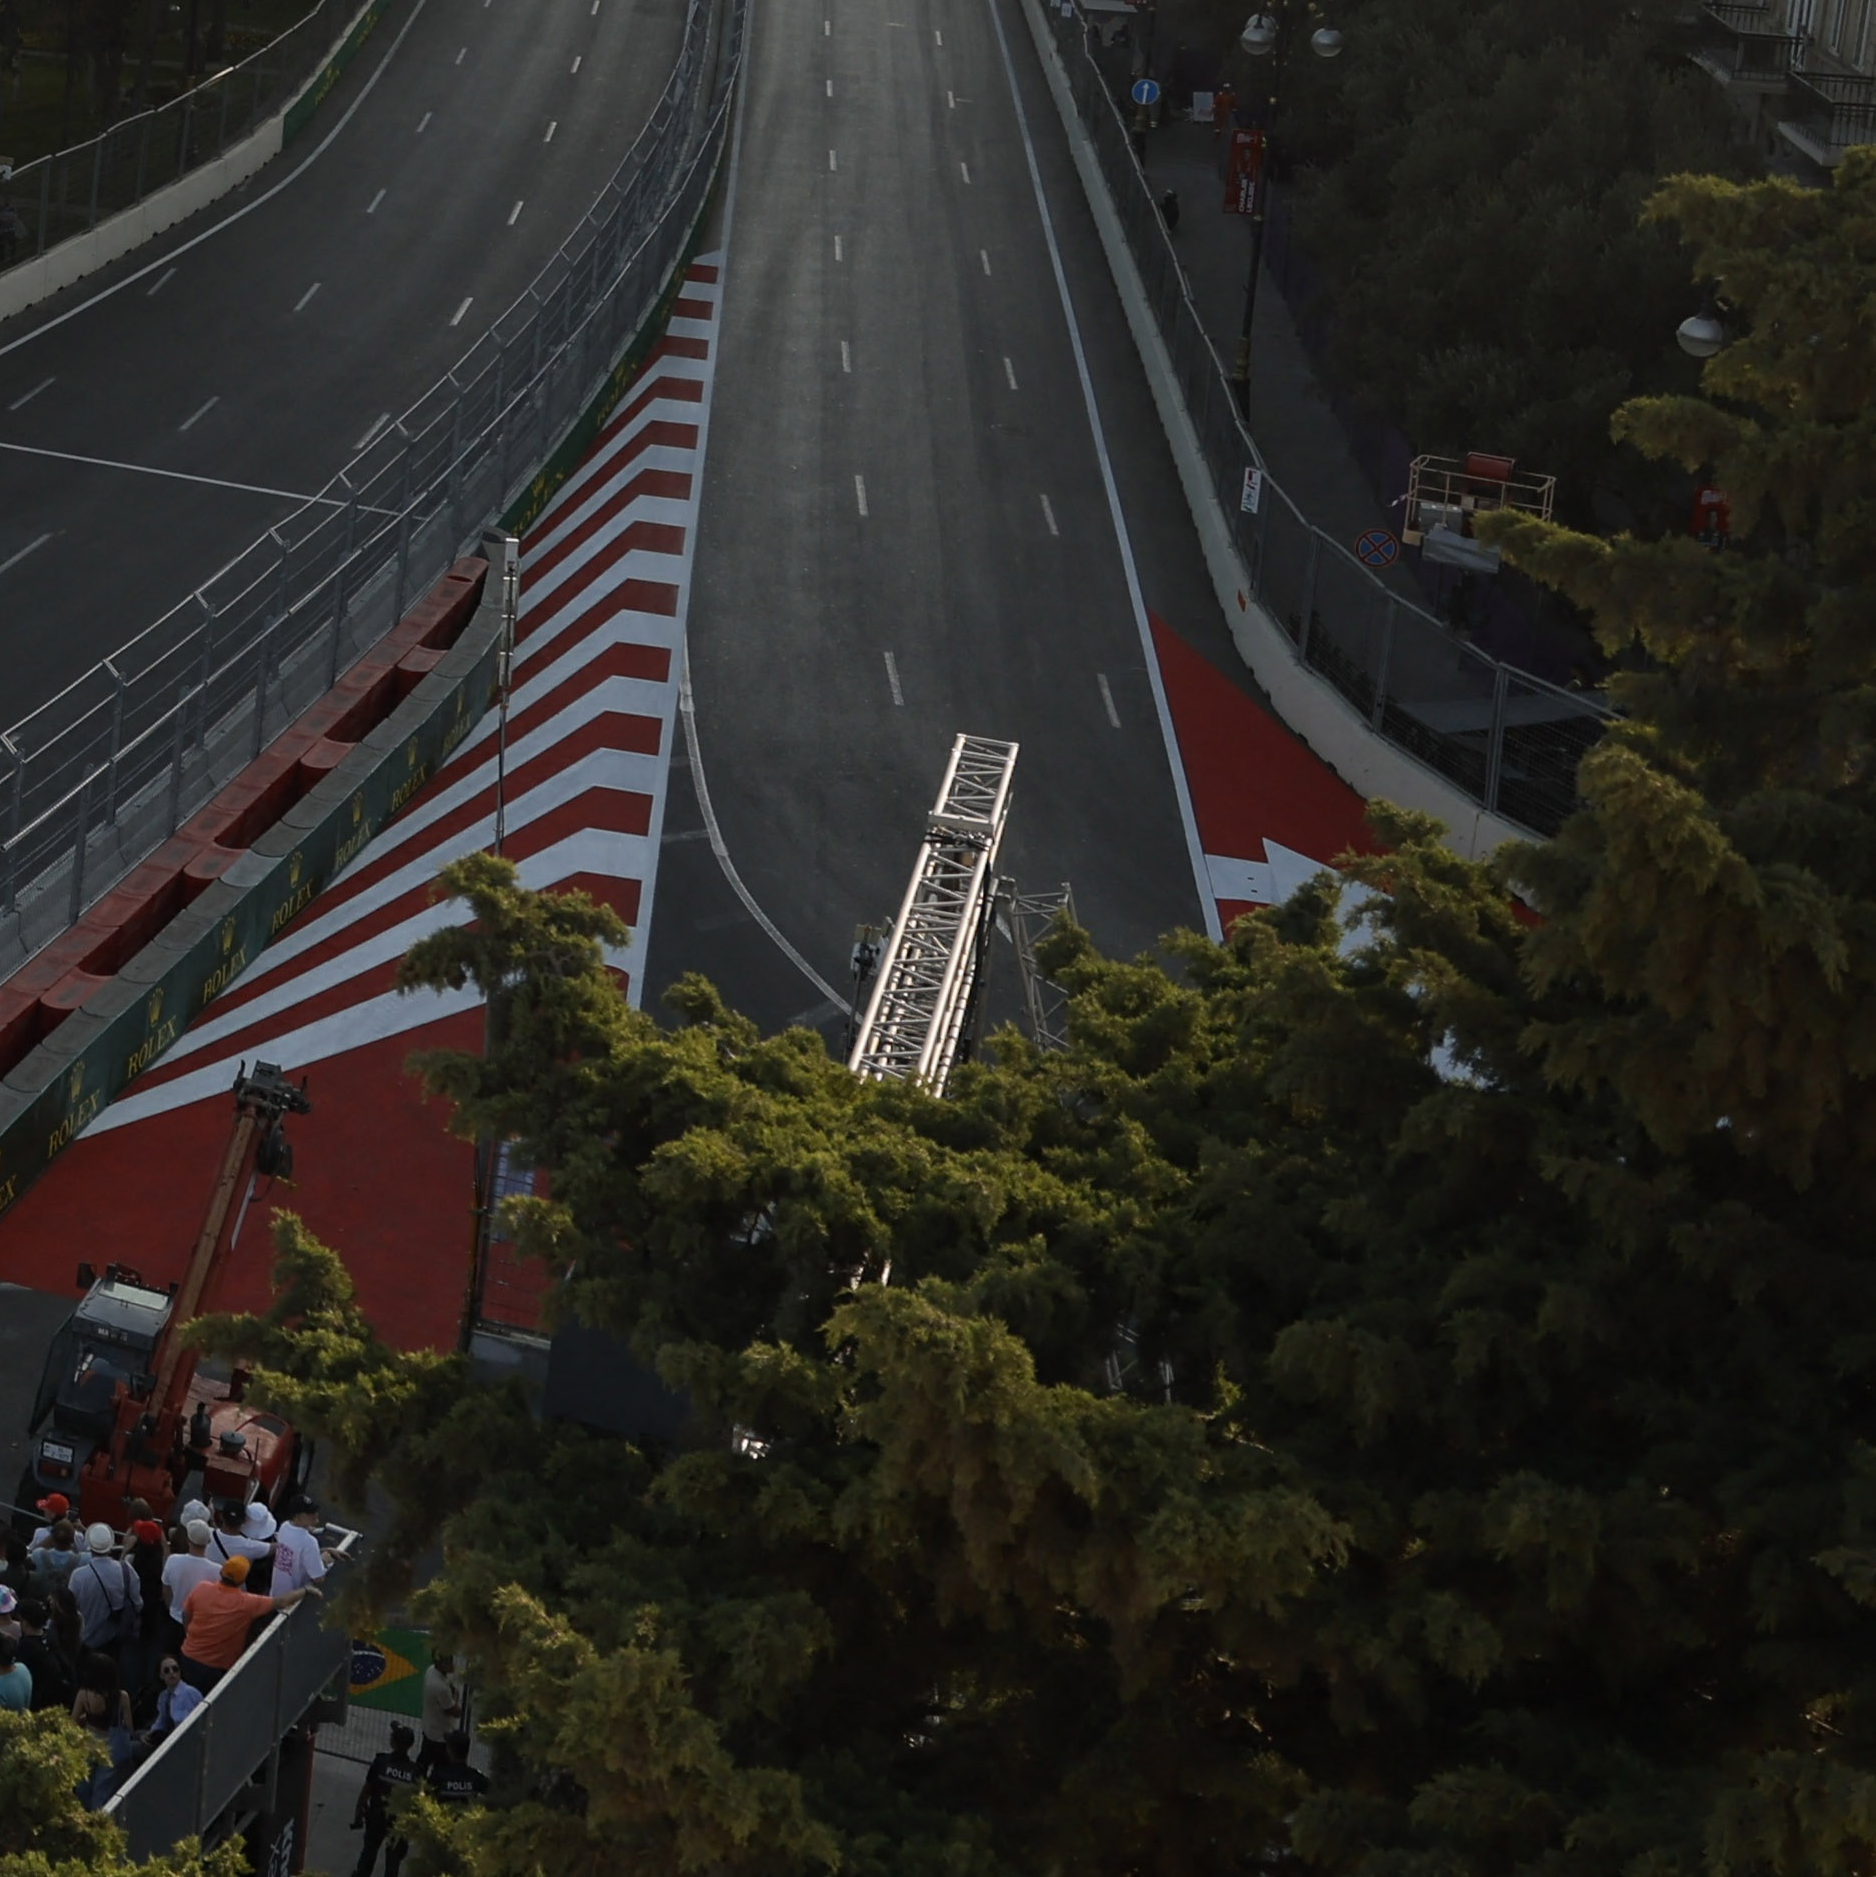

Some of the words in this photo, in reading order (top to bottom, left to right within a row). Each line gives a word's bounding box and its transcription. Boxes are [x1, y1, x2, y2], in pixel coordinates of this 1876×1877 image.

[271, 876, 315, 935] ROLEX
[201, 942, 248, 1005] ROLEX
[126, 1013, 178, 1079] ROLEX
[46, 1088, 102, 1160] ROLEX
